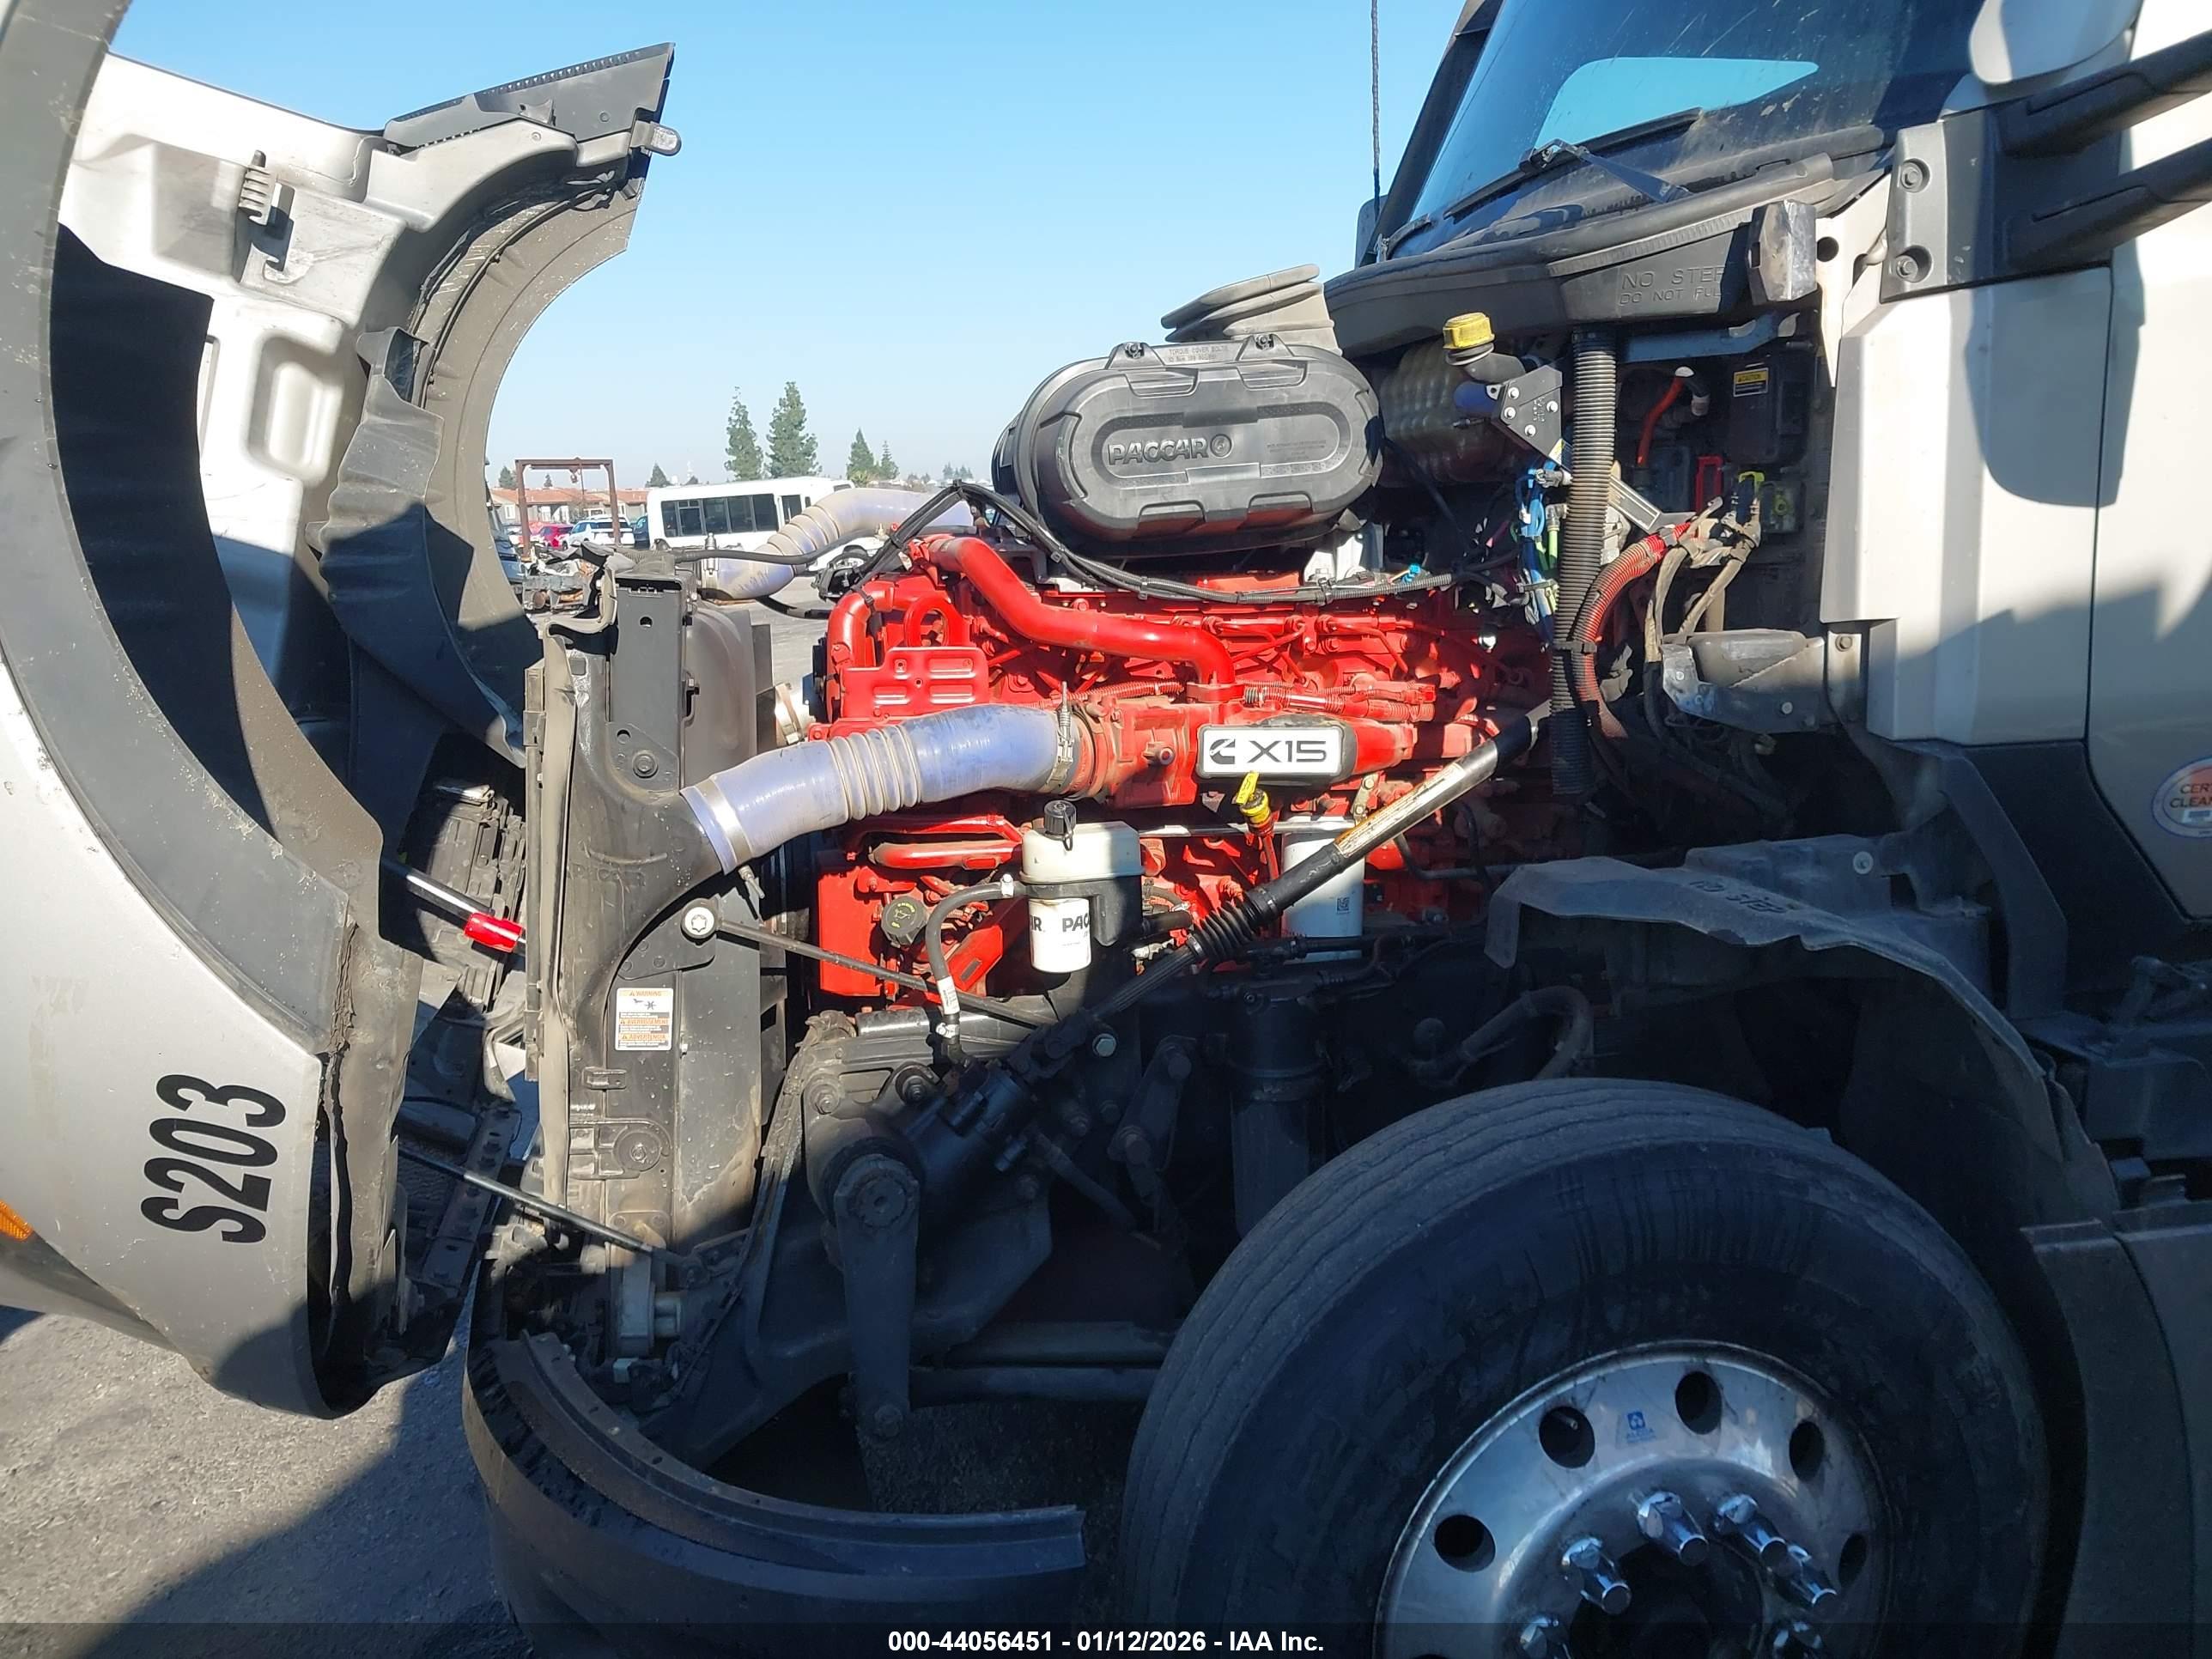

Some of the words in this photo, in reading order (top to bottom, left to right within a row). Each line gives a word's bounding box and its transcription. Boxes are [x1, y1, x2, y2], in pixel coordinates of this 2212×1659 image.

[1621, 270, 1656, 290] NO
[1620, 291, 1643, 306] DO
[1652, 289, 1684, 301] NOT
[1694, 286, 1723, 301] PUL
[1108, 437, 1209, 466] PACCAR
[1247, 740, 1328, 763] X15
[2180, 782, 2212, 794] CER
[2170, 796, 2212, 808] CLEA
[141, 1074, 286, 1243] S203
